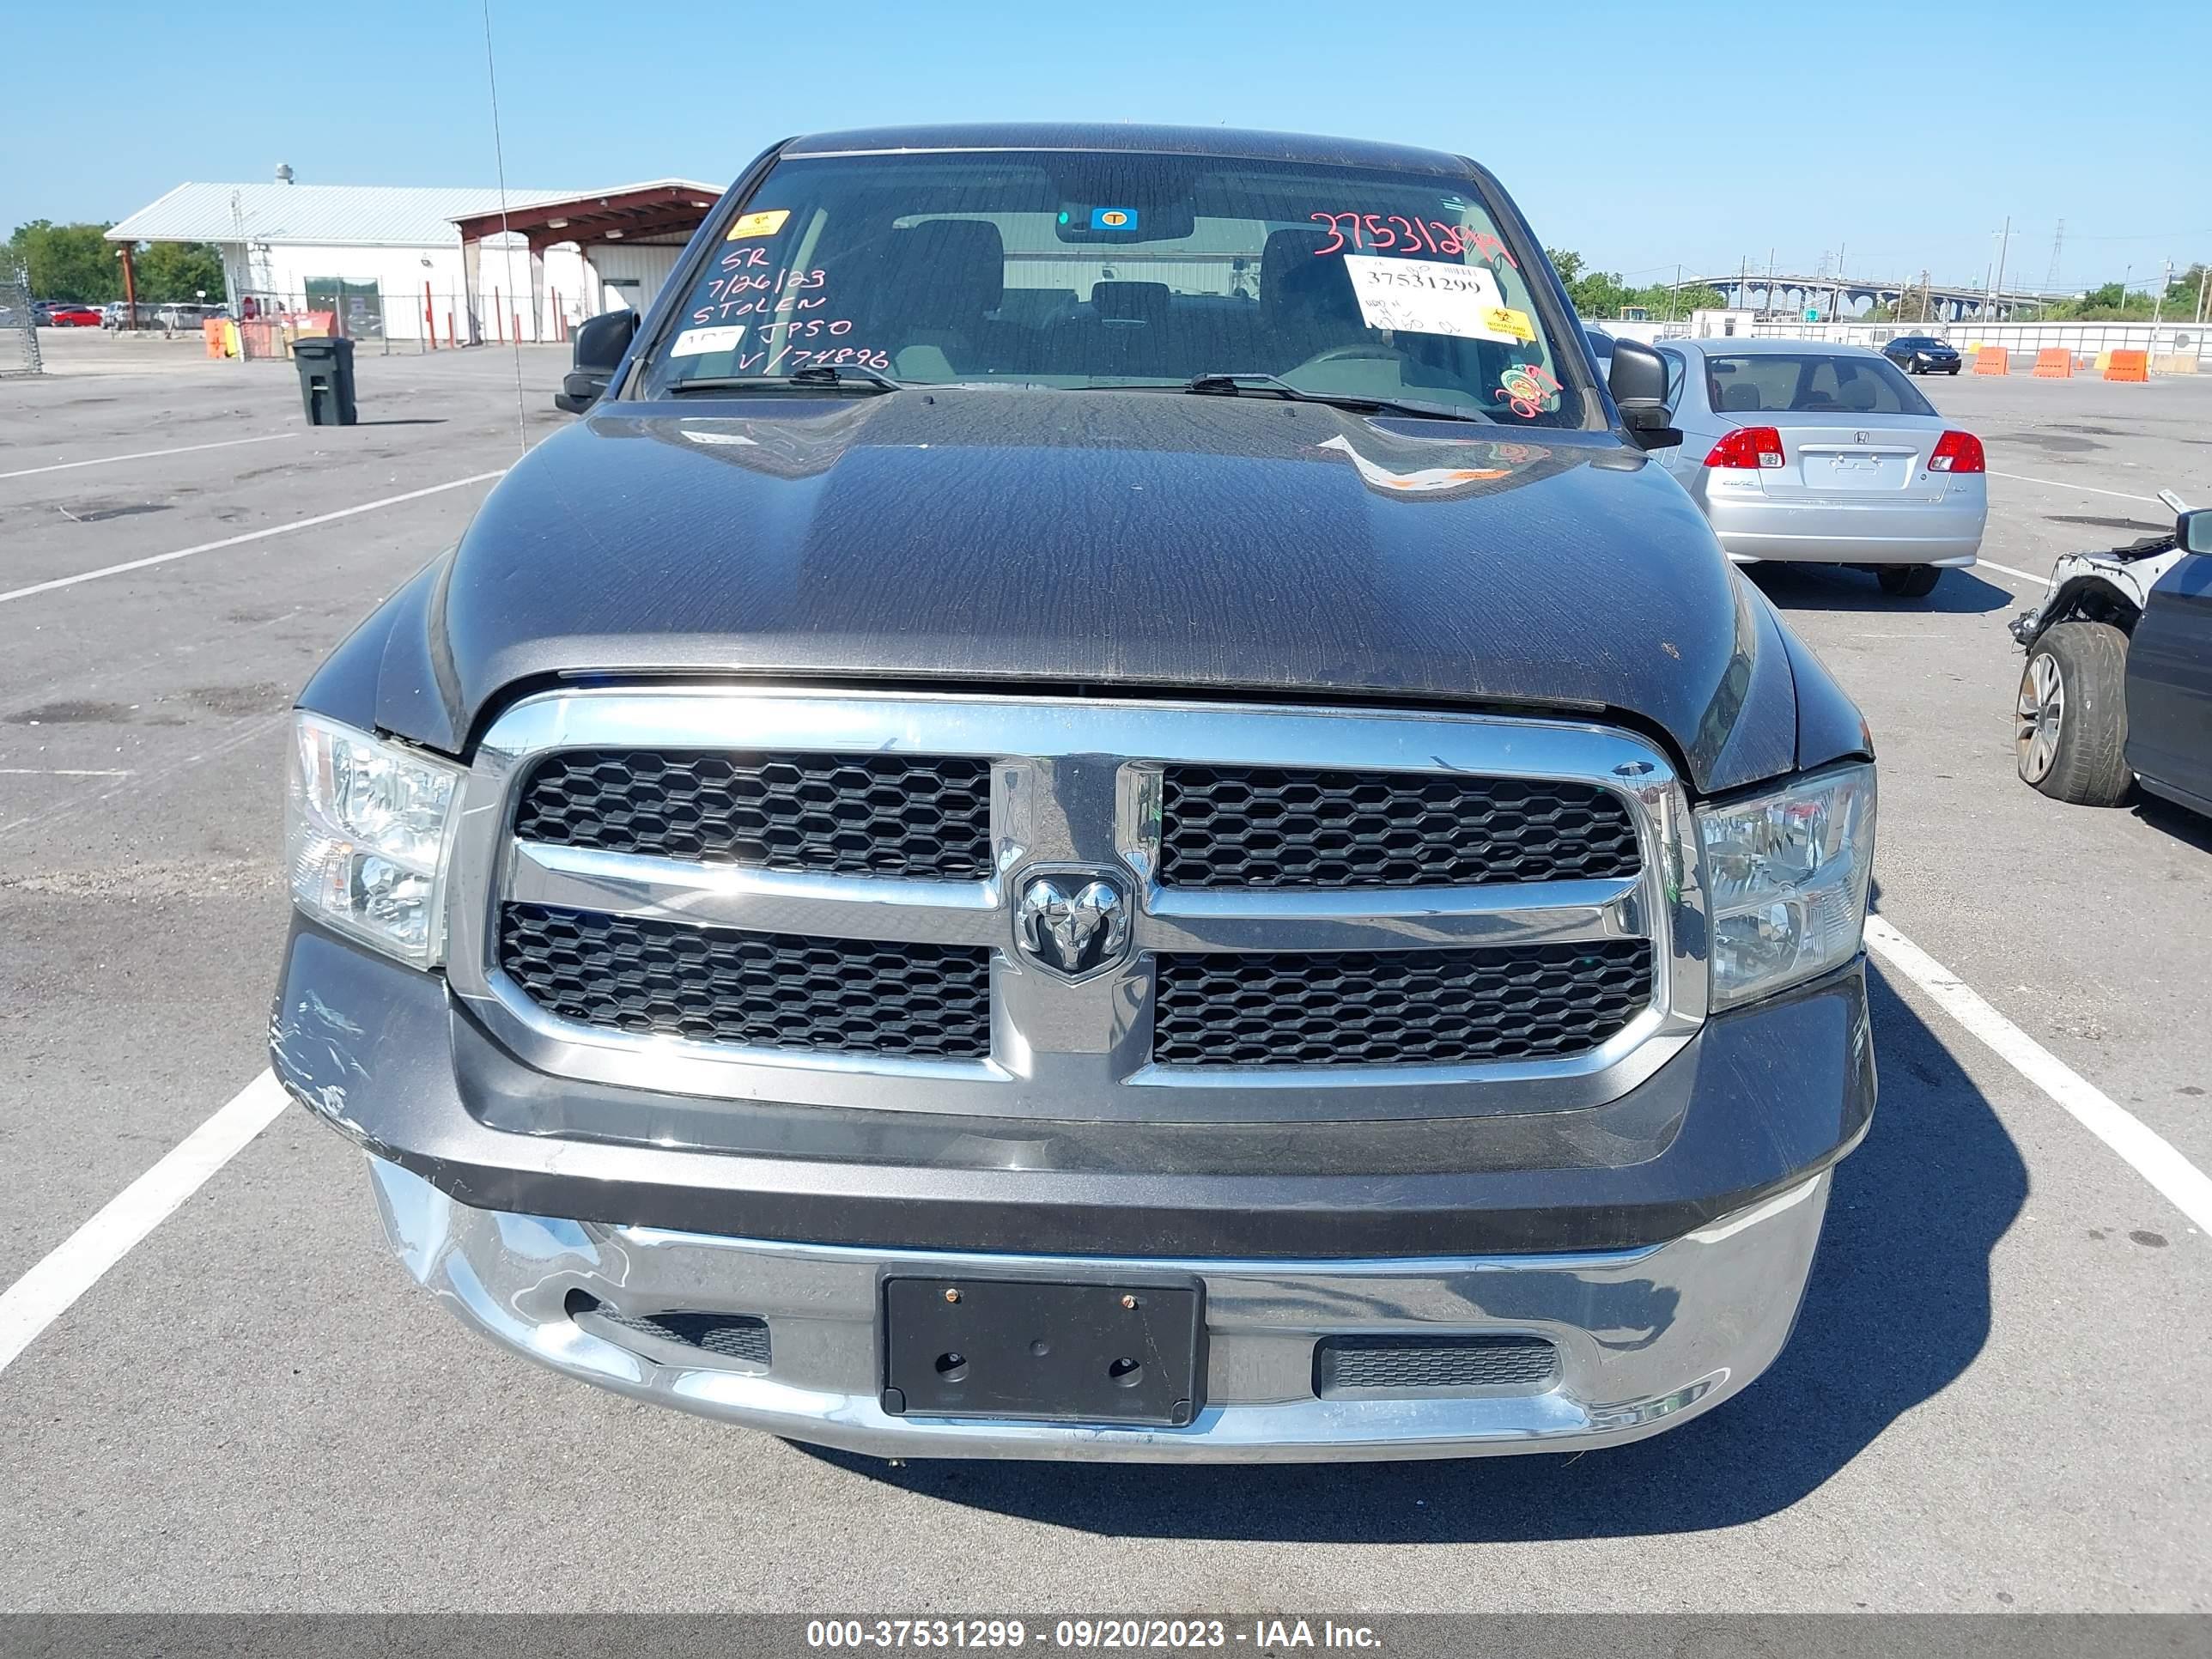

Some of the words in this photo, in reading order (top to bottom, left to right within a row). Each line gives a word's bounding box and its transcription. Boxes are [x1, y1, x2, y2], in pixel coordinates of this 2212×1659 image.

[720, 247, 769, 272] SR
[708, 268, 826, 301] 7/26/23
[1367, 271, 1481, 295] 37531299
[693, 297, 827, 325] STOLEN
[758, 320, 853, 343] JPSO
